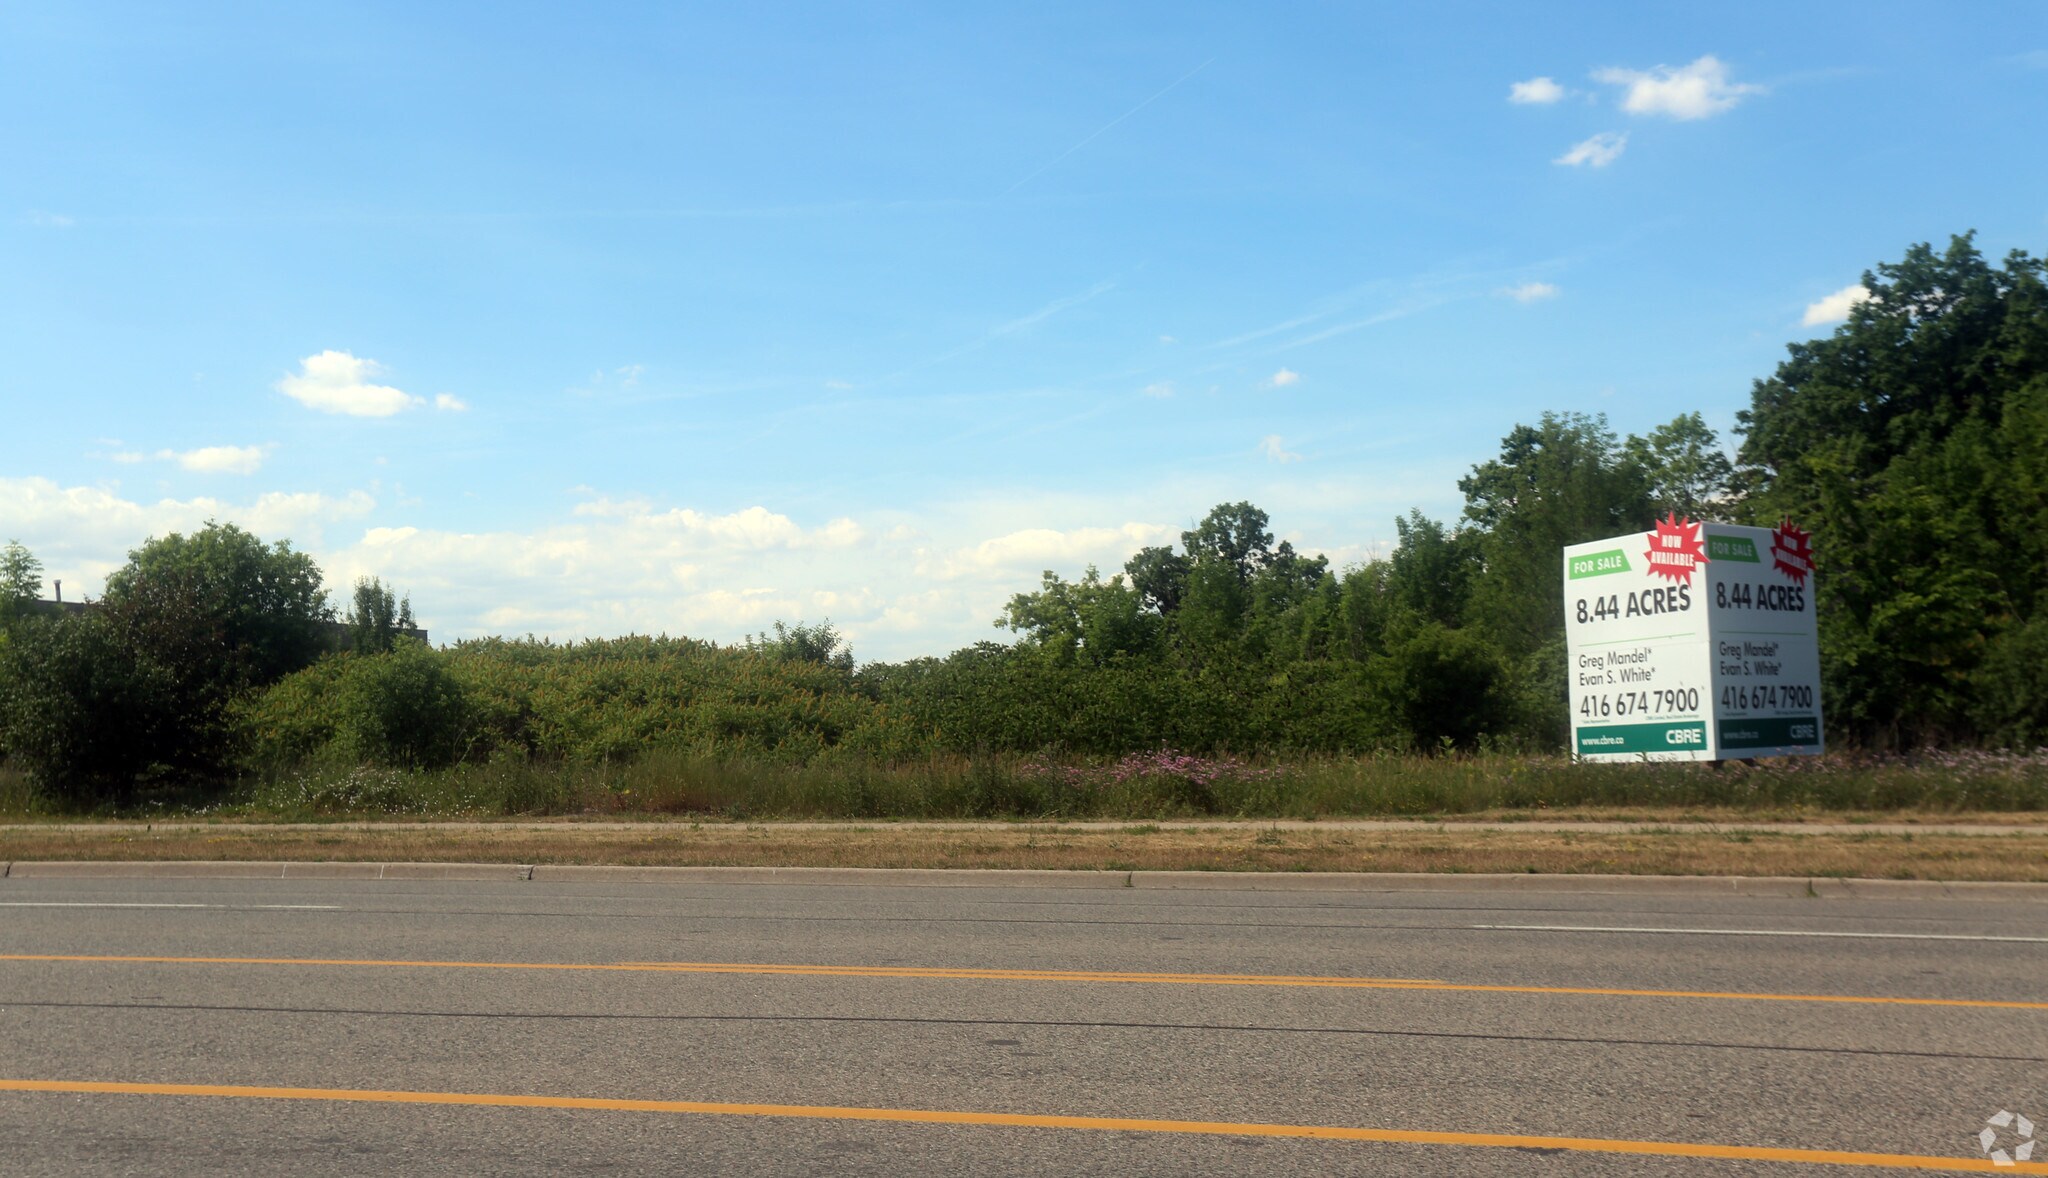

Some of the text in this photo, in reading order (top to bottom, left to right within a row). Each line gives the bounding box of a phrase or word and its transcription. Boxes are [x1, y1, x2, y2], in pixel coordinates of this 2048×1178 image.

[1662, 534, 1682, 549] NOW
[1711, 541, 1753, 557] FOR SALE
[1574, 556, 1622, 574] FOR SALE
[1651, 551, 1695, 567] AVAILABLE
[1576, 584, 1691, 624] 8.44 ACRES
[1716, 581, 1805, 612] 8.44 ACRES
[1720, 641, 1742, 660] Greg
[1579, 654, 1604, 670] Greg
[1720, 661, 1741, 676] Evan
[1579, 672, 1604, 686] Evan
[1607, 669, 1617, 684] S.
[1580, 687, 1699, 717] 416 674 7900
[1721, 685, 1813, 709] 416 674 7900
[1665, 728, 1702, 744] CBRE
